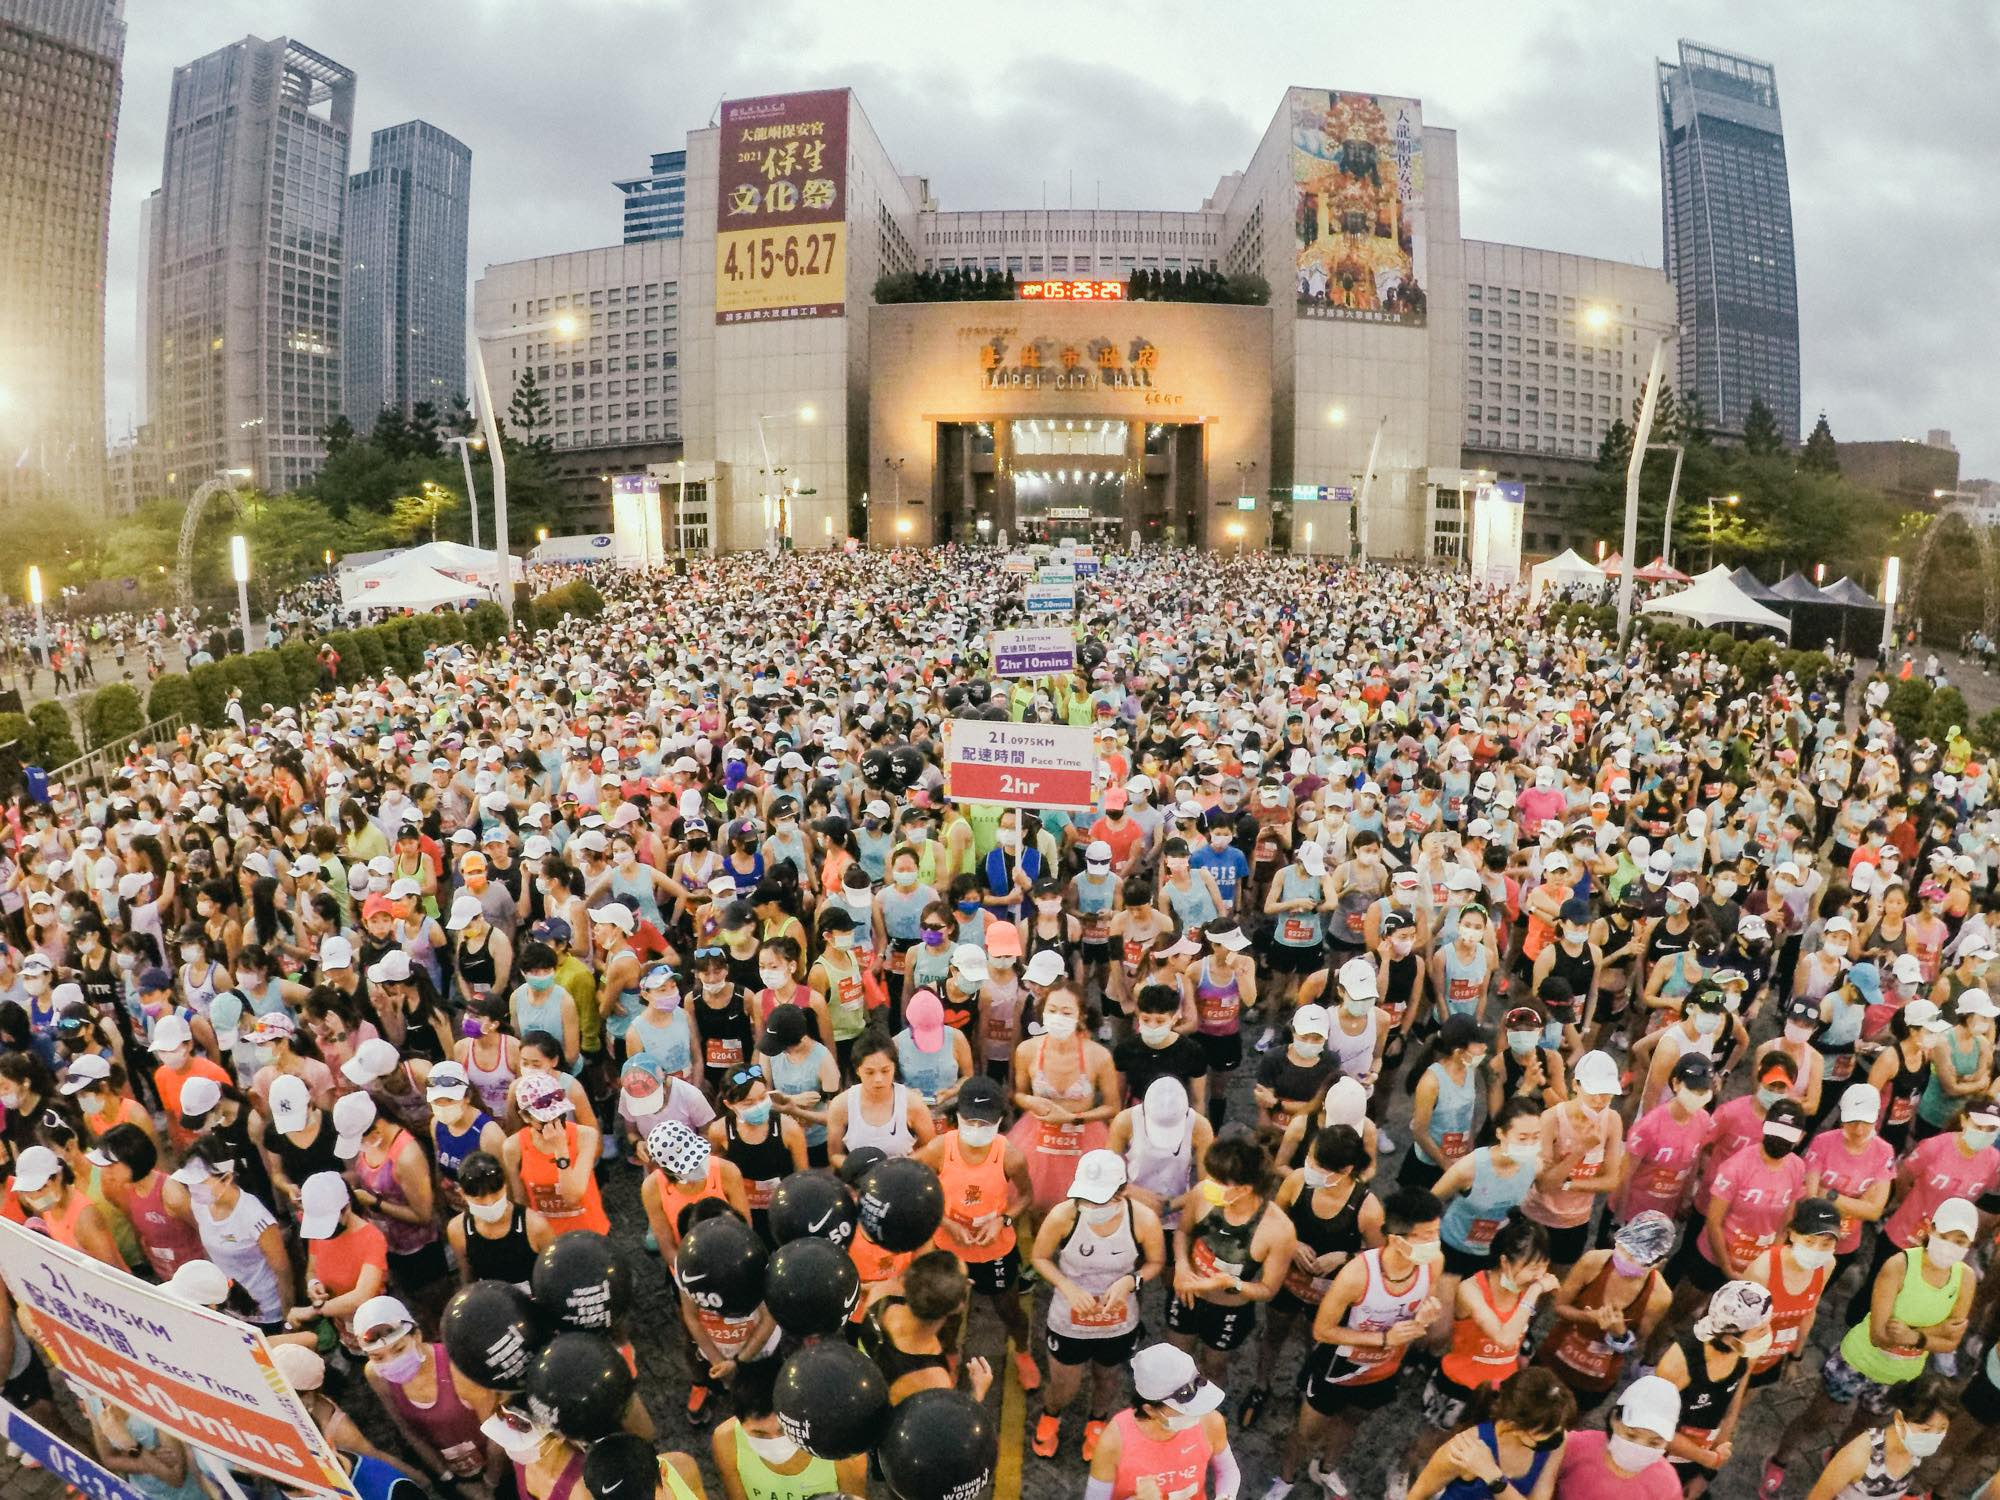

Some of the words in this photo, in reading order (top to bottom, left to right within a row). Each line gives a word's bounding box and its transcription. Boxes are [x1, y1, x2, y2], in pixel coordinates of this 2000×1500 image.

[738, 152, 761, 162] 2021
[728, 178, 835, 216] 文化祭
[1043, 281, 1121, 298] 05:25:29
[981, 374, 1041, 390] TAIPEI
[1056, 374, 1097, 390] CITY
[1000, 659, 1022, 670] 2hr
[1024, 656, 1069, 669] 10mins
[962, 746, 1025, 765] 配速時間
[1031, 757, 1053, 766] Pace
[1056, 758, 1081, 767] Time
[999, 774, 1040, 795] 2hr
[40, 1262, 173, 1343] 21.0975KM
[20, 1277, 138, 1361] 配速時間
[146, 1352, 195, 1385] Pace
[199, 1373, 260, 1407] Time
[953, 1476, 981, 1493] TAISHIN
